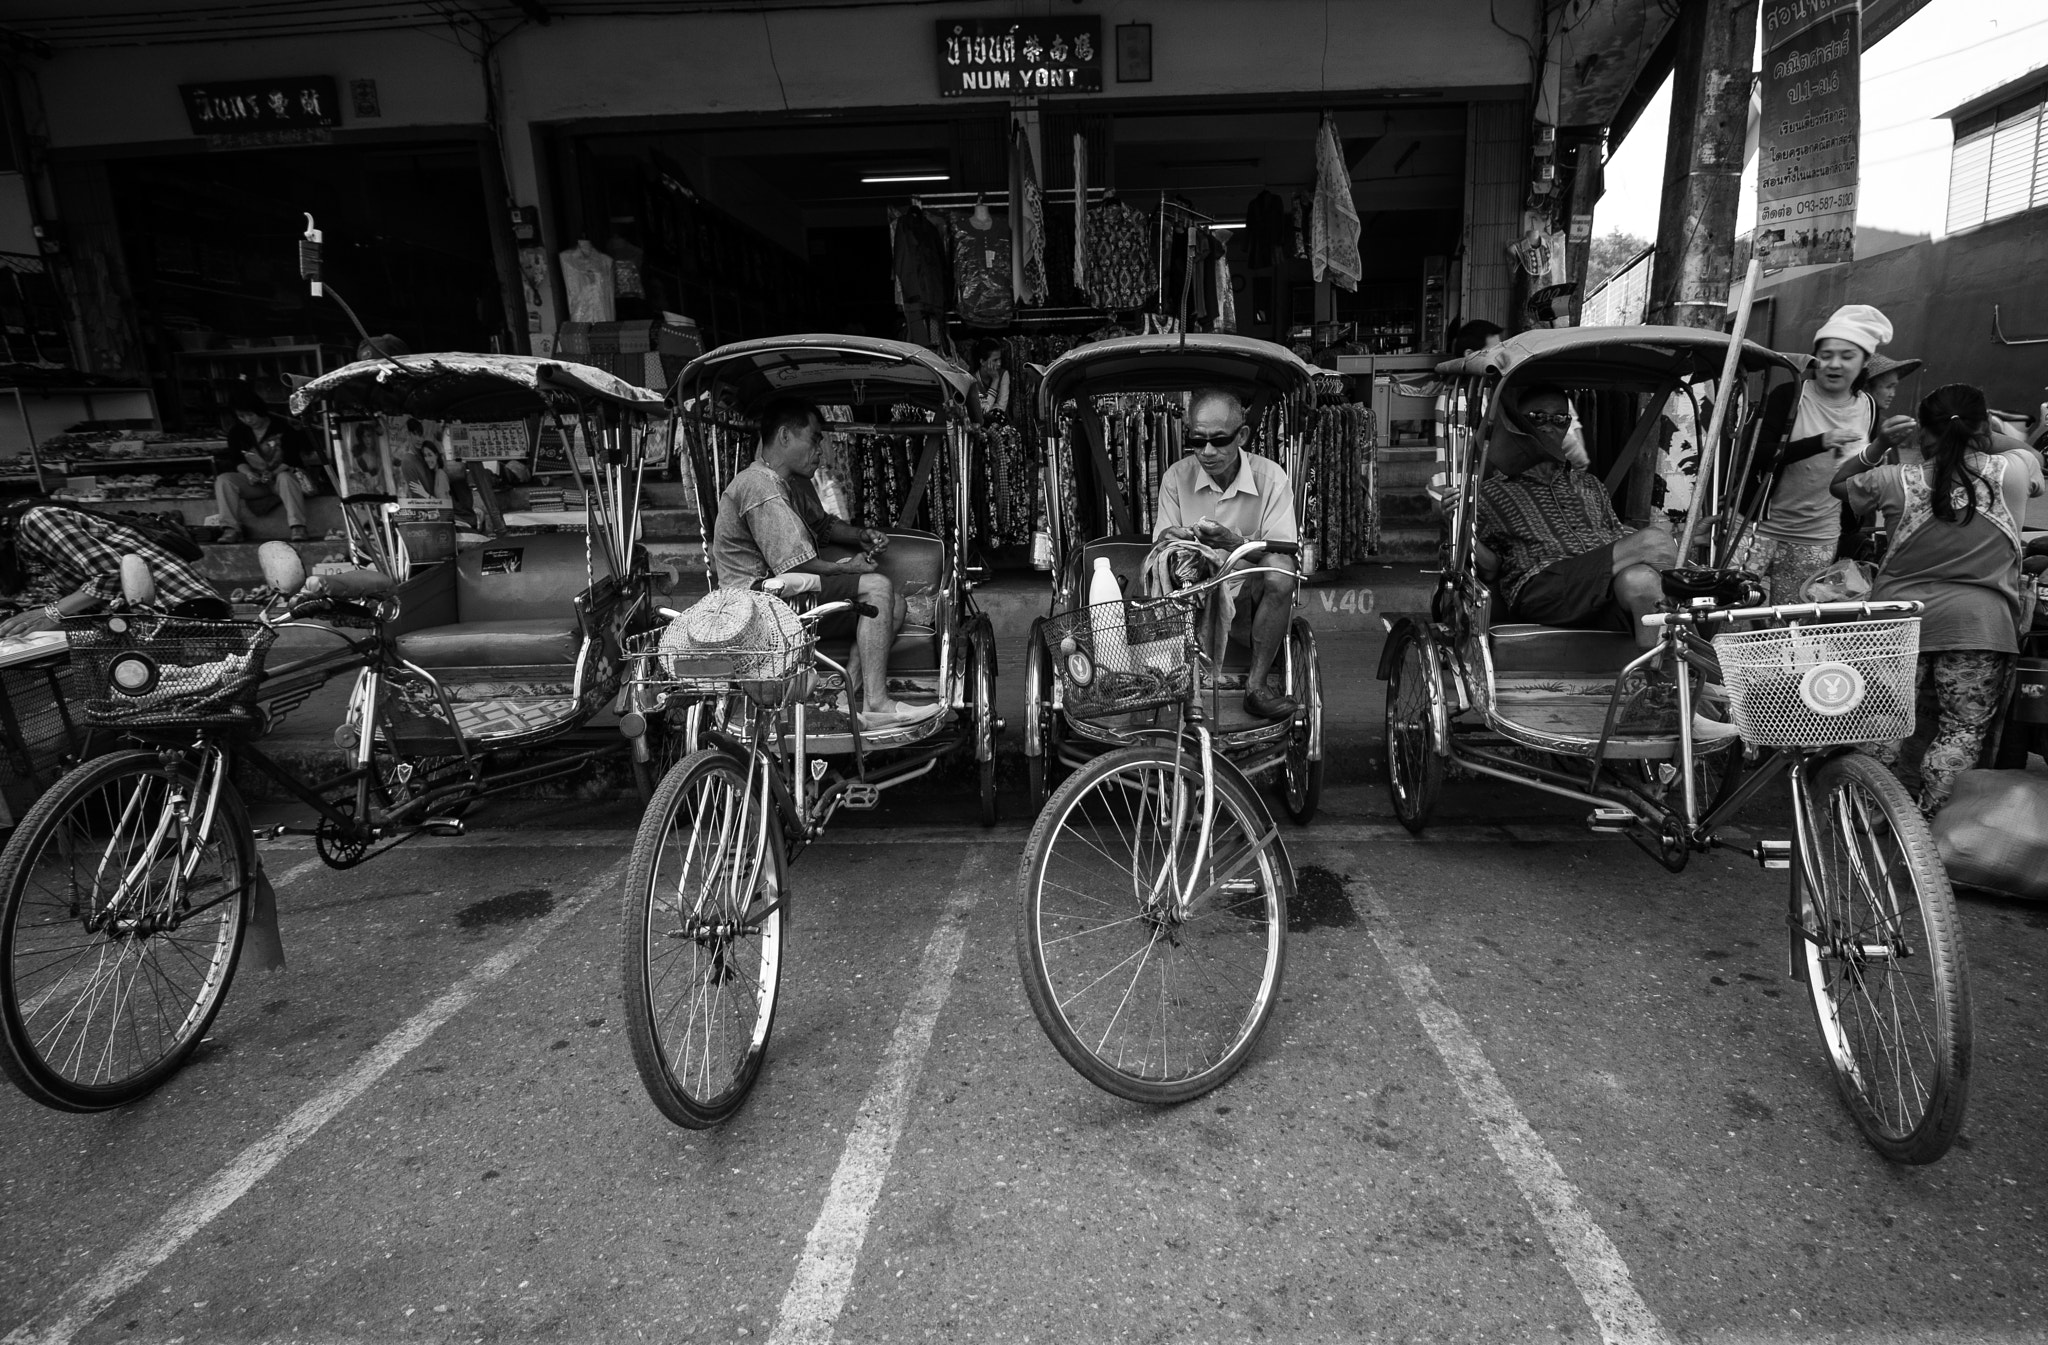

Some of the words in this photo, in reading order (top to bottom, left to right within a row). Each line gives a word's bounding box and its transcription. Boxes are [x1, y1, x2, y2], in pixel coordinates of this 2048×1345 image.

[1774, 29, 1850, 79] คณิตศาสตร์
[962, 70, 1010, 90] NUM
[1019, 68, 1078, 88] YONT
[1787, 70, 1839, 105] ป.1-ม.6
[1762, 204, 1792, 221] ติดต่อ
[1319, 588, 1374, 614] V.40
